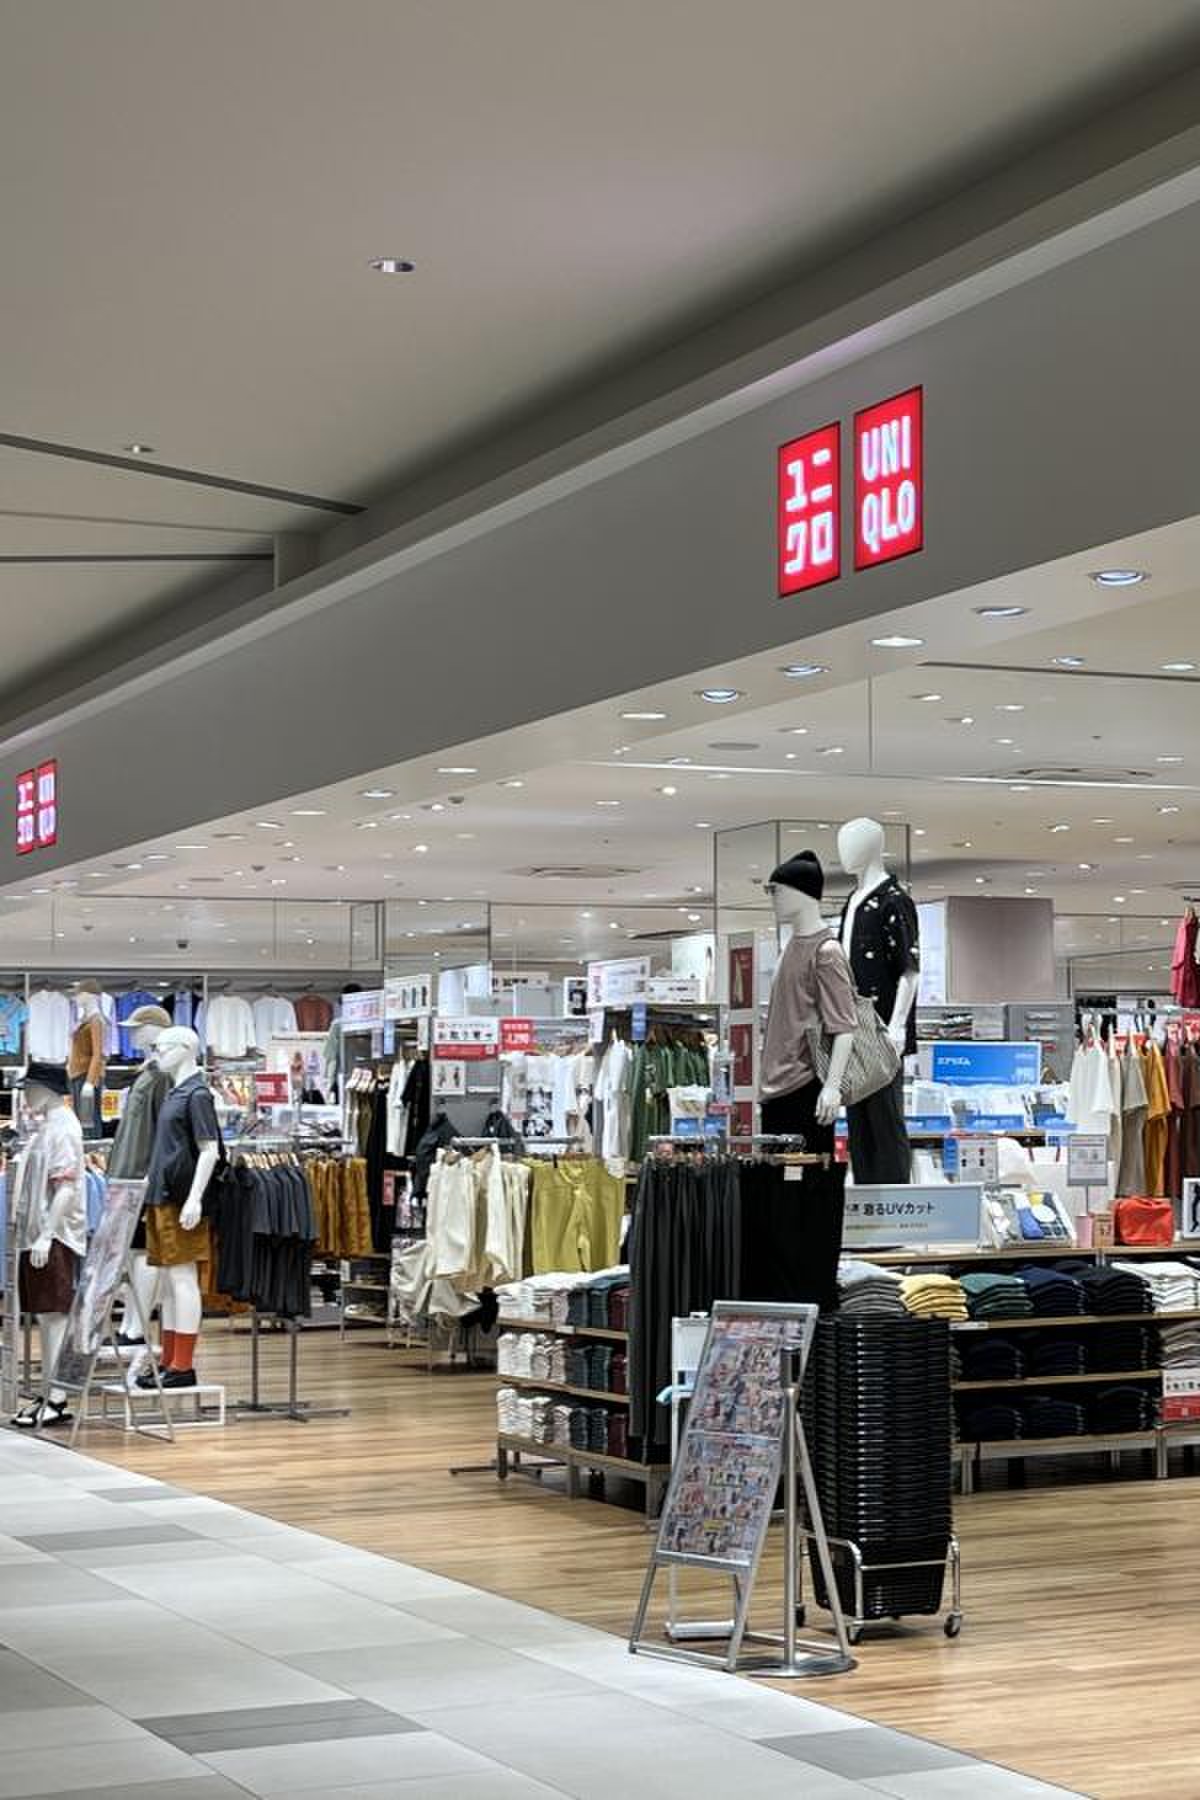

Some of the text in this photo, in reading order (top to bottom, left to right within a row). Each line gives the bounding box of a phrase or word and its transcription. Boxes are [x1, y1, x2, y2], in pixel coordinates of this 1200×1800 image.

[785, 447, 832, 512] ユニ
[861, 415, 911, 482] UNI
[784, 511, 833, 575] クロ
[861, 479, 916, 554] QLO
